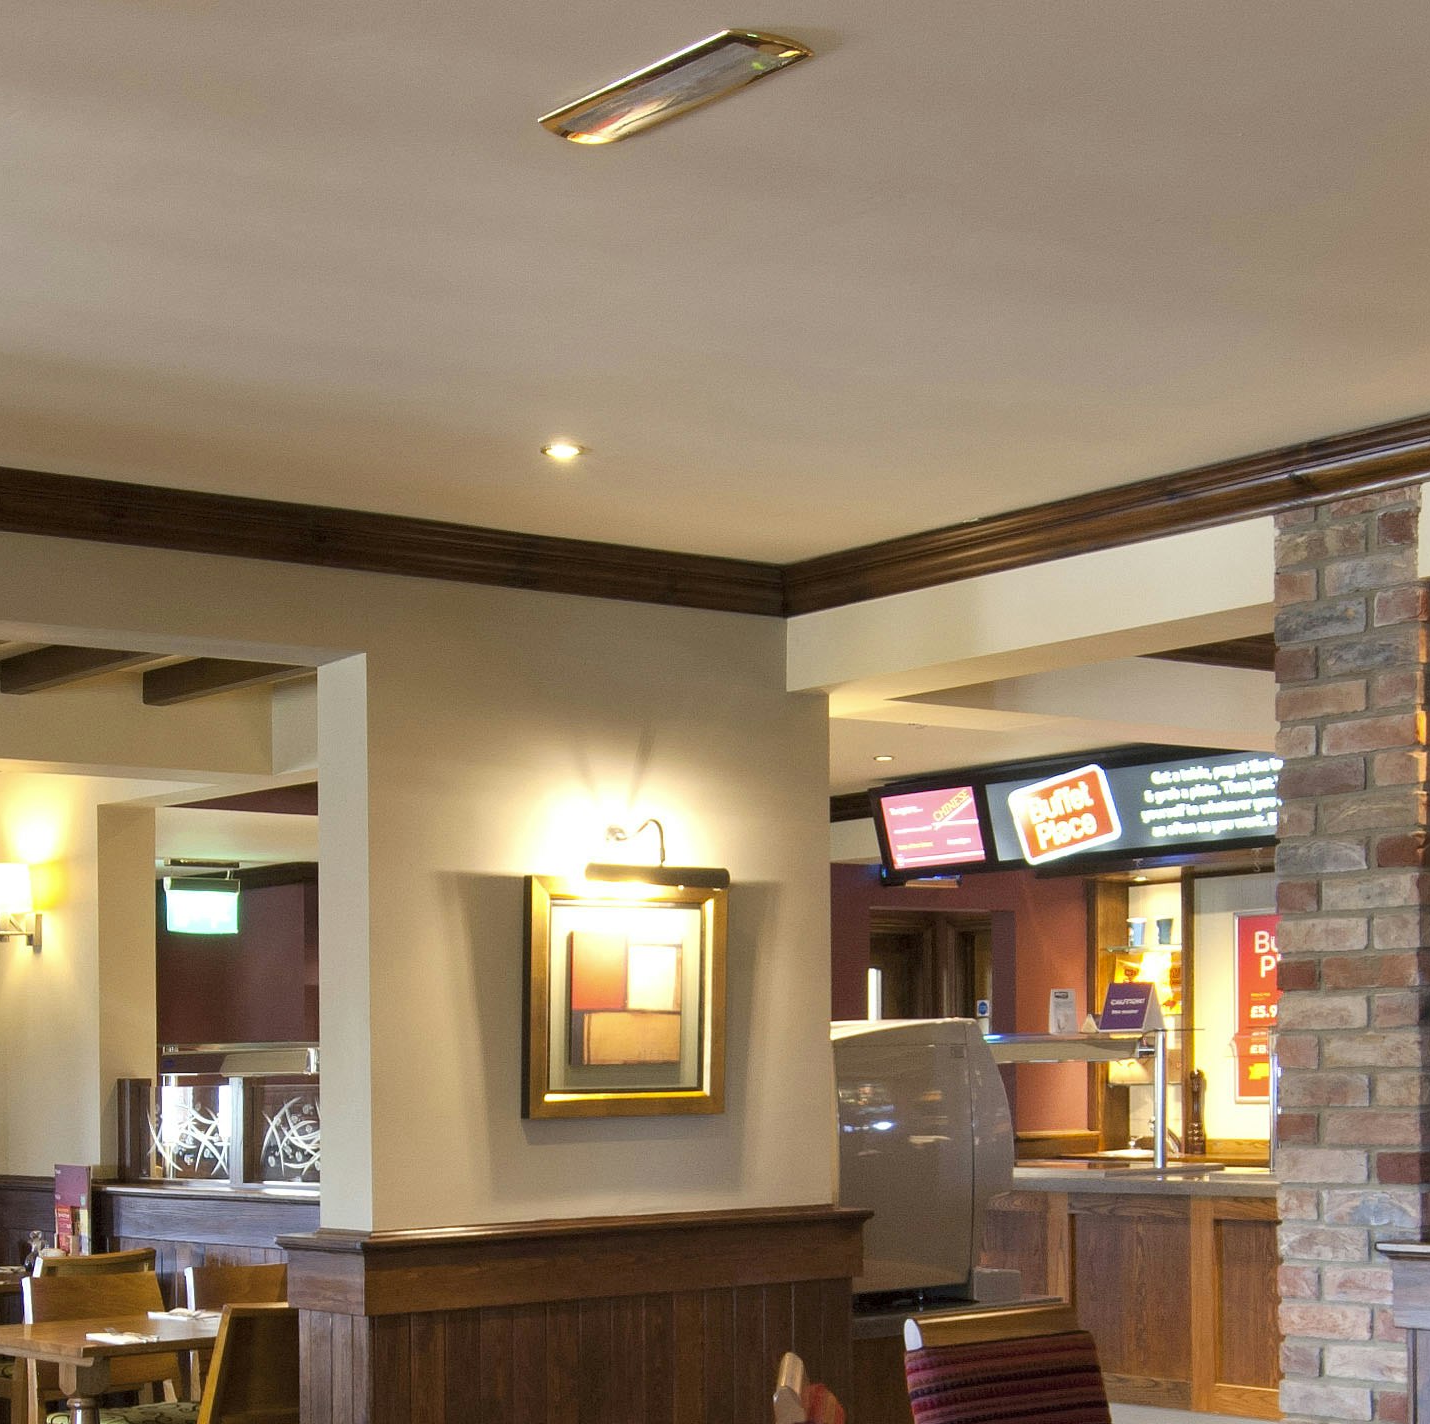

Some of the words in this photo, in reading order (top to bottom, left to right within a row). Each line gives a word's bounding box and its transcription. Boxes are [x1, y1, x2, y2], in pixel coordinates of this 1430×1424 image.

[932, 788, 971, 822] CHINESE
[1029, 781, 1094, 825] Buffet
[1035, 812, 1098, 850] Place
